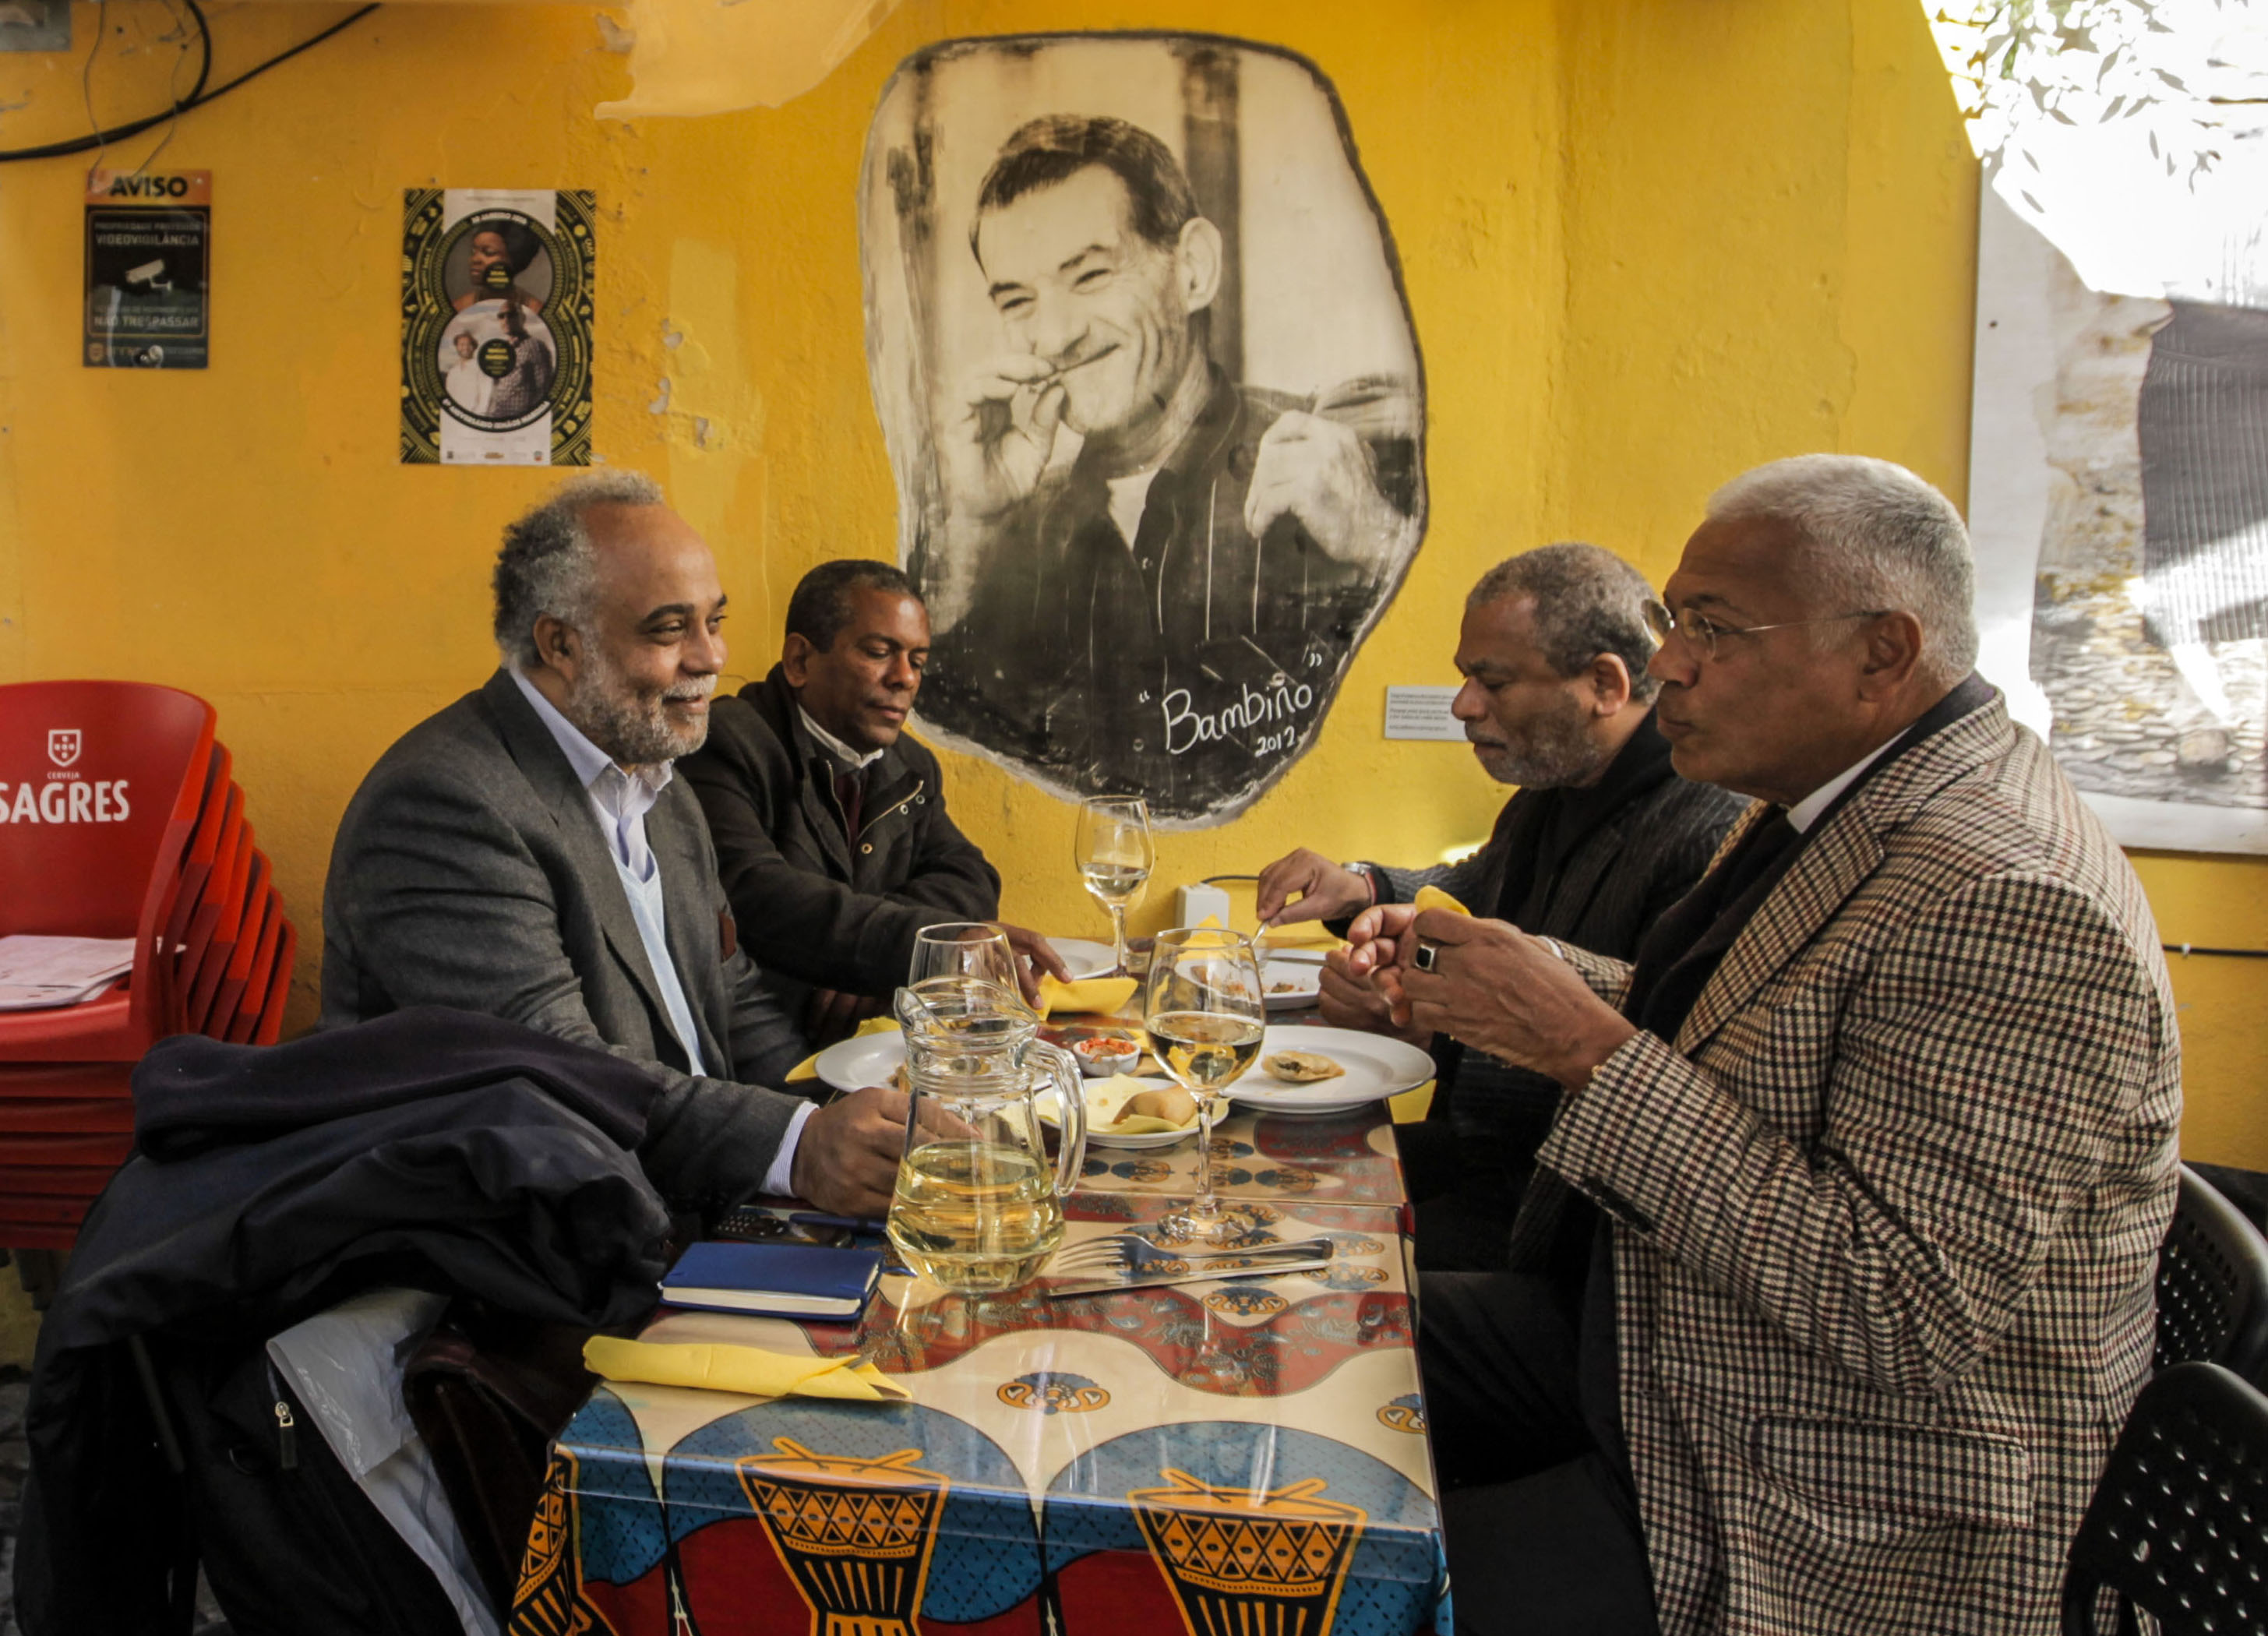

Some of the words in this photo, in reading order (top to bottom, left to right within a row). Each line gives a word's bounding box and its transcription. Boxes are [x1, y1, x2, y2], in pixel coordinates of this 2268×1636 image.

[109, 176, 188, 198] AVISO
[47, 771, 80, 780] CERVEJA
[0, 780, 130, 824] SAGRES
